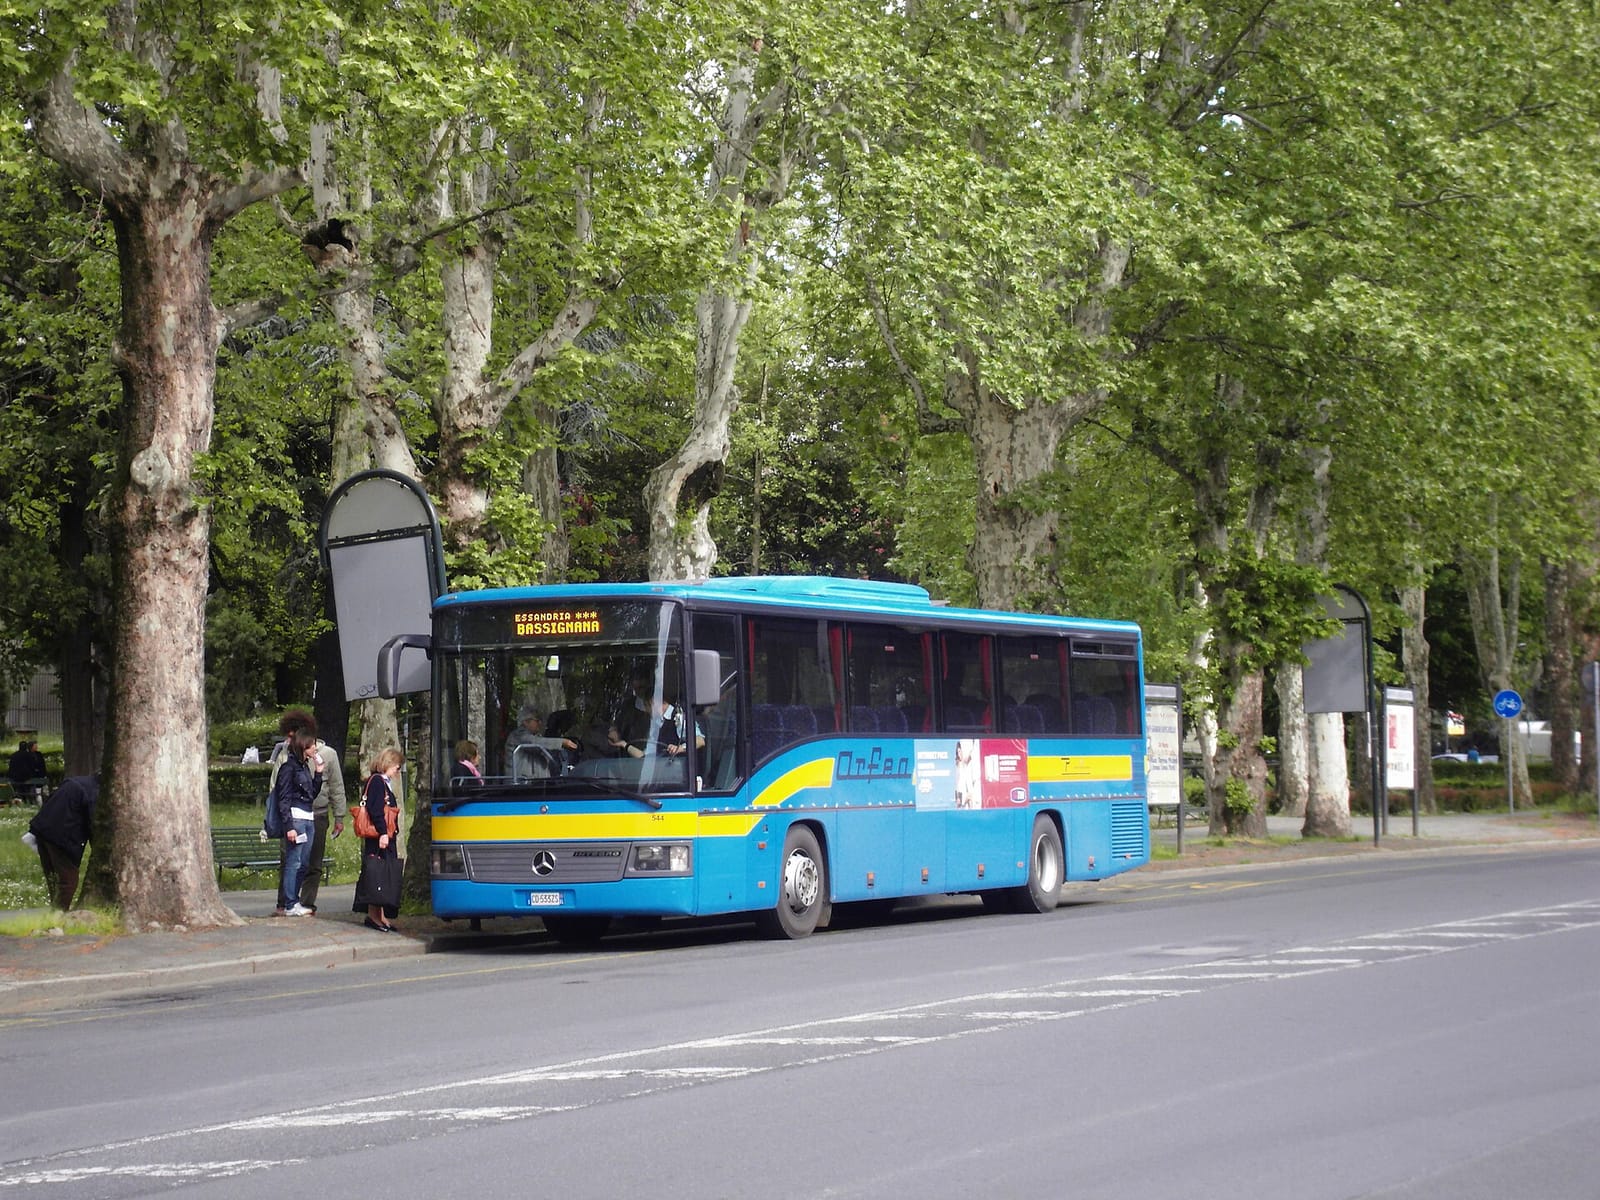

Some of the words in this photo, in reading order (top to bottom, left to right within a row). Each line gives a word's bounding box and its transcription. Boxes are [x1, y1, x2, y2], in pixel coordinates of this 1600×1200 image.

[514, 612, 571, 622] ESSANDRIA
[517, 620, 600, 635] BASSIGNANA
[651, 814, 665, 822] 544
